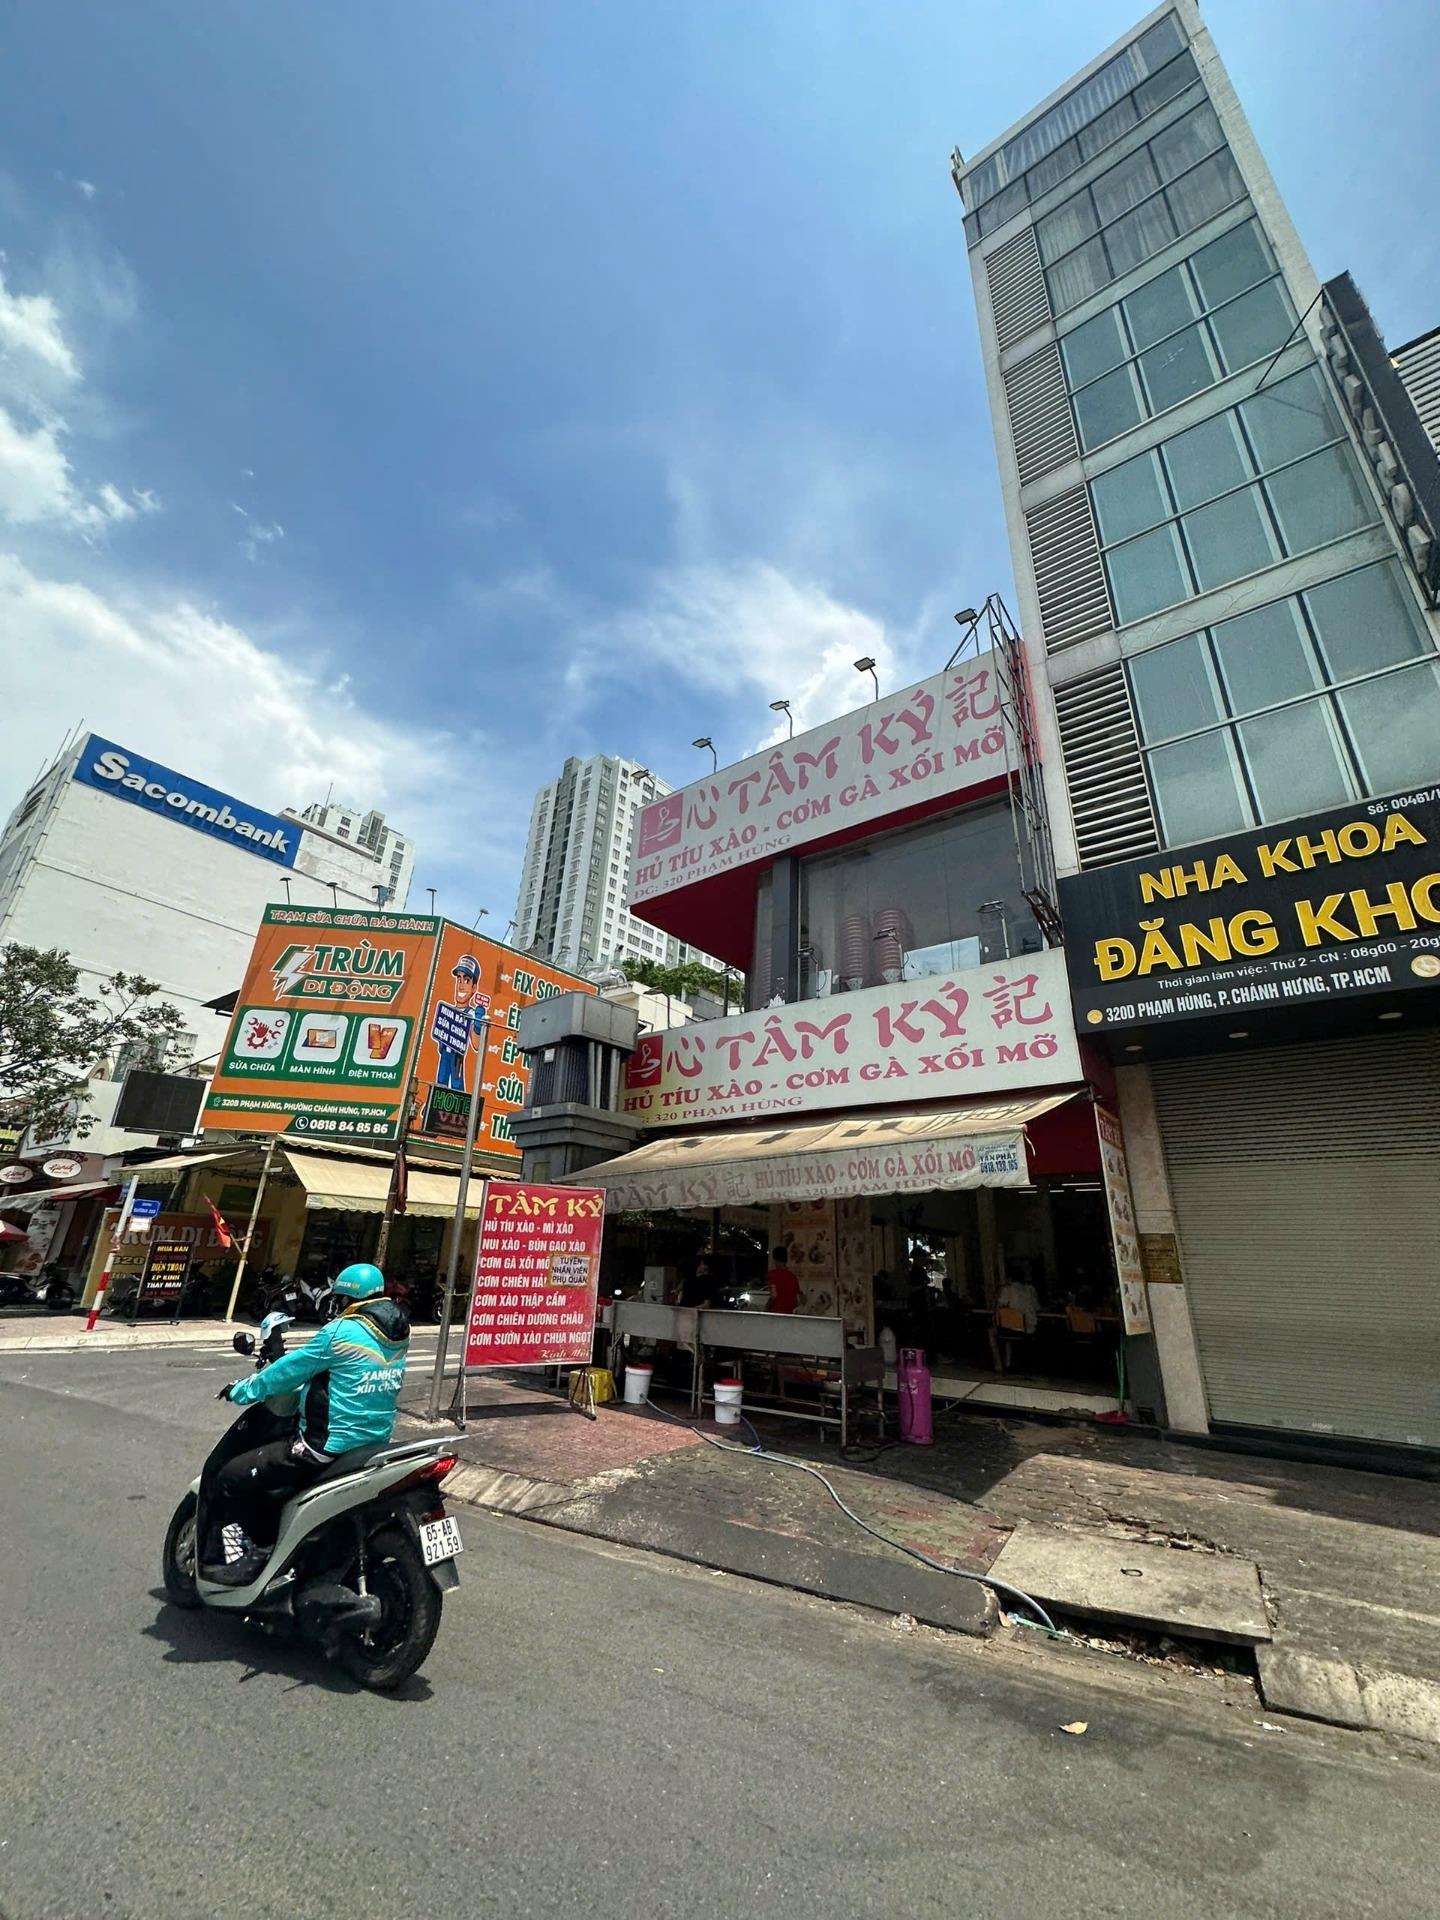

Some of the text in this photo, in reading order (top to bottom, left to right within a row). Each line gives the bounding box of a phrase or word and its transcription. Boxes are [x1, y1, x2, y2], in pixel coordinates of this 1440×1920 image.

[946, 669, 1000, 727] 記
[728, 736, 841, 814] TÂM
[93, 751, 290, 854] Sacombank
[635, 725, 1006, 886] HỦ TÍU XÀO CƠM GÀ XỐI MỠ
[687, 785, 719, 830] 心
[1367, 801, 1389, 815] Số:
[662, 875, 680, 889] 320
[686, 856, 734, 882] PHẠM
[741, 833, 791, 859] HÙNG
[1139, 812, 1428, 903] NHA KHOA
[271, 910, 434, 931] TRẠM SỬA CHỮA BẢO HÀNH
[314, 939, 406, 977] TRÙM
[1094, 909, 1280, 981] ĐĂNG
[1185, 974, 1210, 989] gian
[1212, 969, 1234, 982] làm
[1237, 963, 1268, 978] việc:
[1270, 958, 1296, 972] Thứ
[1299, 957, 1308, 966] 2
[1319, 951, 1339, 963] CN
[1350, 942, 1397, 959] 08g00
[303, 980, 392, 999] DI ĐỘNG
[513, 969, 535, 997] FIX
[1106, 965, 1392, 1022] 320D PHẠM HÙNG, P. CHÁNH HƯNG, TP.HCM
[982, 974, 1053, 1029] 記
[715, 1012, 852, 1072] TÂM
[229, 1060, 275, 1072] SỬA CHỮA
[667, 1036, 705, 1077] 心
[290, 1065, 336, 1076] MÀN HÌNH
[348, 1069, 397, 1080] ĐIỆN THOẠI
[624, 1033, 1058, 1111] HỦ TÍU XÀO CƠM GÀ XỐI MỠ
[496, 1072, 524, 1105] SỬA
[240, 1100, 261, 1110] PHẠM
[314, 1103, 339, 1113] CHÁNH
[655, 1112, 678, 1122] 320
[682, 1102, 735, 1119] PHẠM
[740, 1096, 803, 1113] HÙNG
[309, 1119, 389, 1134] 0818 84 85 86
[848, 1157, 880, 1181] CƠM
[884, 1151, 908, 1178] GÀ
[913, 1144, 943, 1174] XỐI
[949, 1143, 976, 1172] MỠ
[489, 1190, 559, 1216] TÂM
[485, 1217, 574, 1234] HỦ TÍU XÀO MÌ XÀO
[482, 1238, 499, 1250] NUI
[502, 1237, 520, 1251] XÀO
[528, 1237, 547, 1251] BÚN
[569, 1239, 586, 1252] XÀO
[480, 1254, 536, 1269] CƠM GÀ XỐI
[478, 1275, 499, 1288] CƠM
[475, 1294, 497, 1307] CƠM
[499, 1293, 518, 1307] XÀO
[520, 1293, 544, 1309] THẬP
[472, 1313, 495, 1325] CƠM
[527, 1314, 558, 1325] DƯƠNG
[560, 1312, 584, 1324] CHÂU
[470, 1332, 492, 1346] CƠM
[522, 1330, 542, 1344] XÀO
[544, 1332, 567, 1344] CHUA
[358, 1382, 376, 1394] xin
[425, 1520, 453, 1542] 65-AB
[426, 1535, 460, 1562] 921.59
